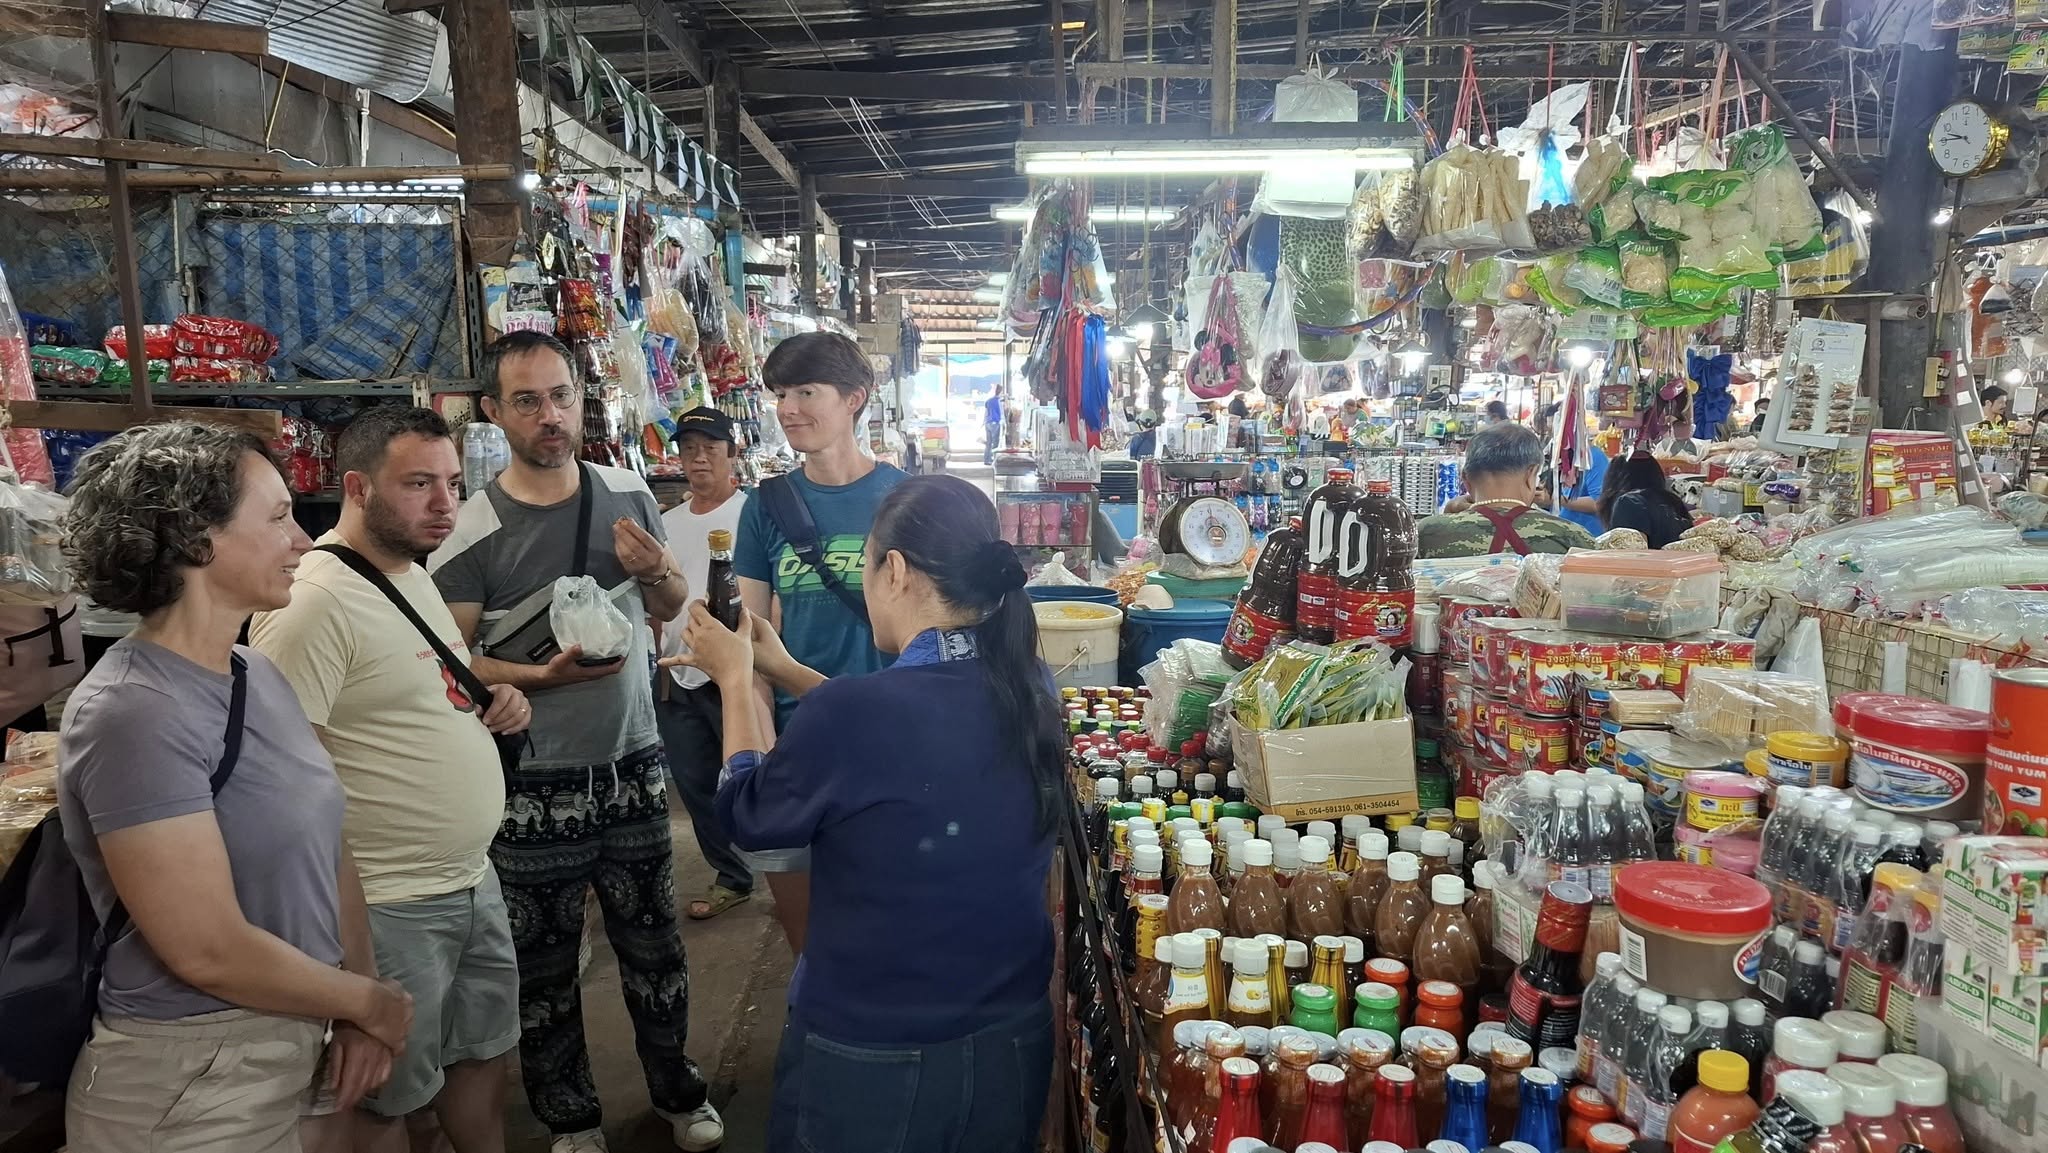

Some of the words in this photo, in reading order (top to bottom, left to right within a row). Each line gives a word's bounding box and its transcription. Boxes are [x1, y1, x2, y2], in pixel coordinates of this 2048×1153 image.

[1962, 105, 1970, 115] 12
[1951, 112, 1958, 121] 11
[1943, 123, 1951, 132] 10
[1944, 149, 1950, 159] 8
[1953, 158, 1959, 167] 7
[1962, 160, 1970, 169] 6
[1993, 761, 2014, 773] TOM
[2017, 766, 2047, 779] YUM
